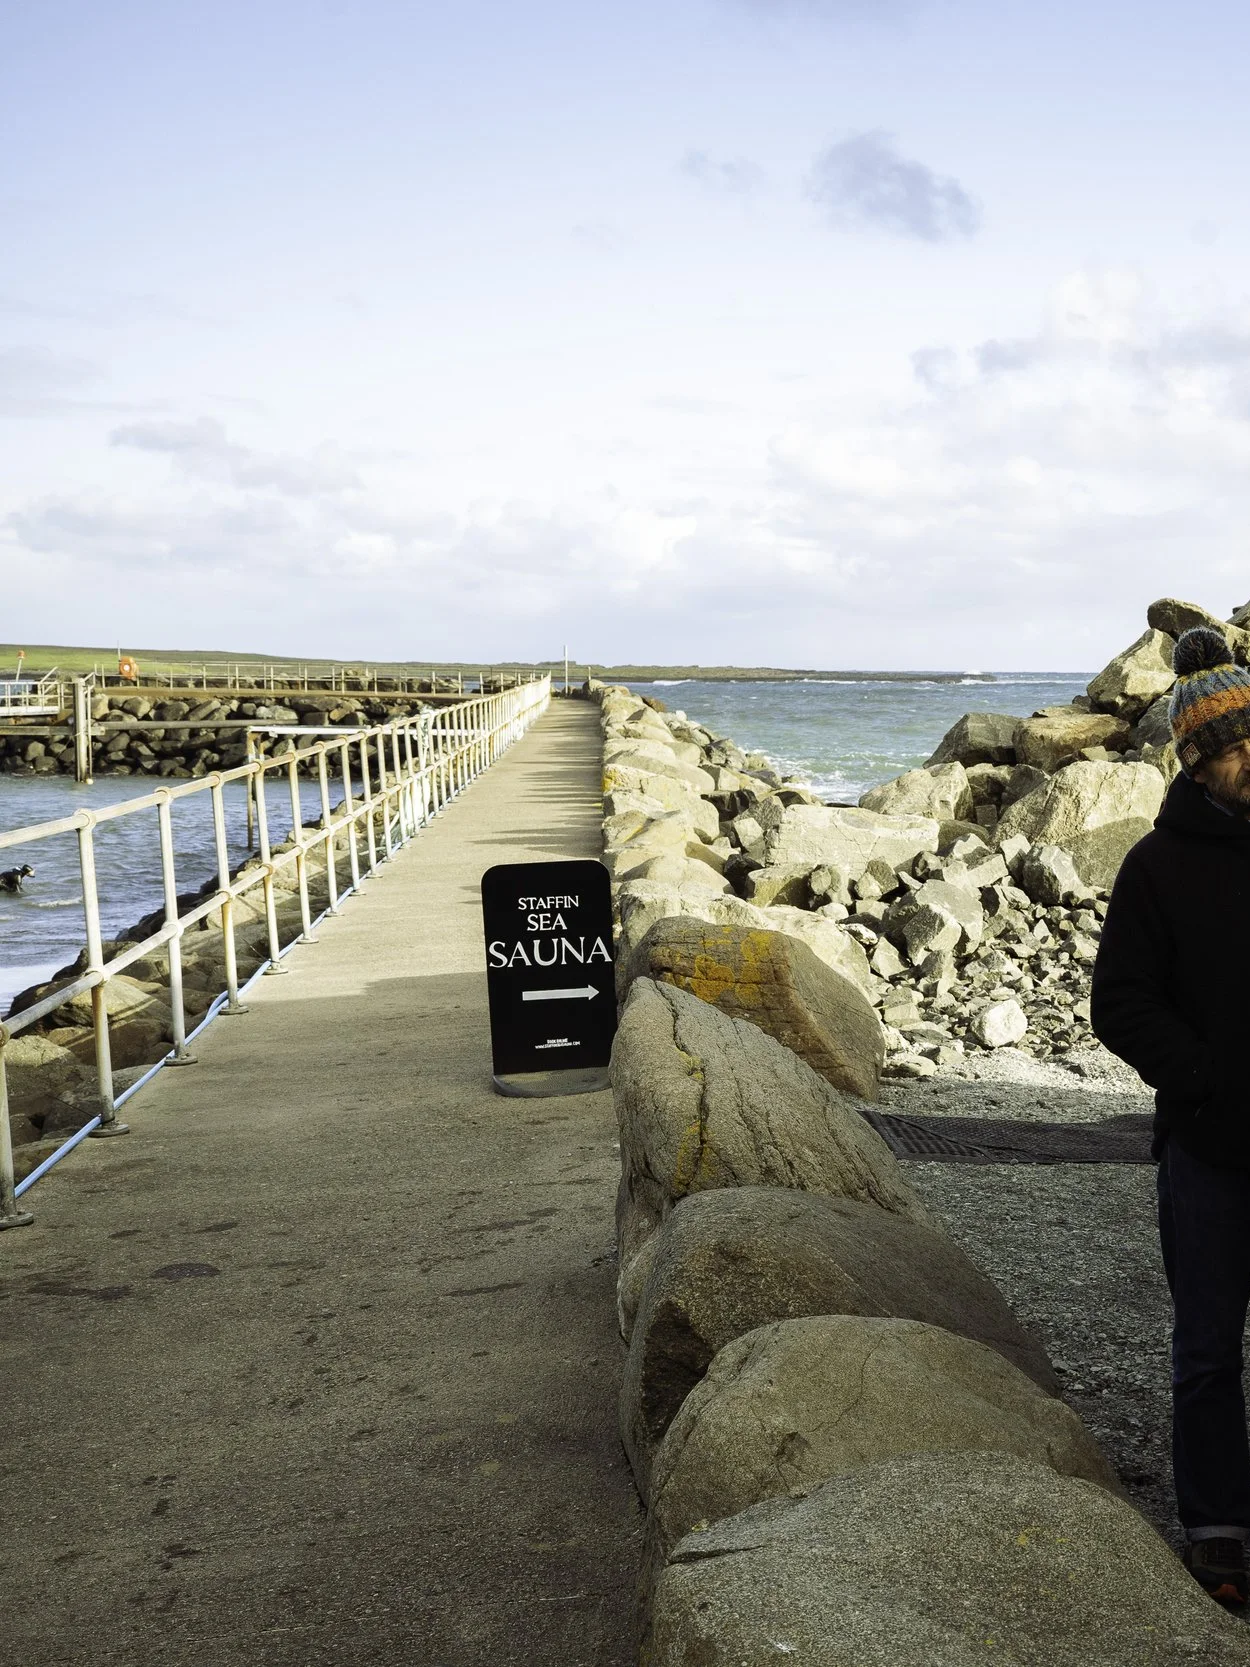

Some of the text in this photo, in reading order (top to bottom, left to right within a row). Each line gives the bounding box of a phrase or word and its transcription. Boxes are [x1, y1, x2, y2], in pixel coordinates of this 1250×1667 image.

[517, 895, 579, 911] STAFFIN
[526, 912, 568, 932] SEA
[488, 936, 613, 968] SAUNA
